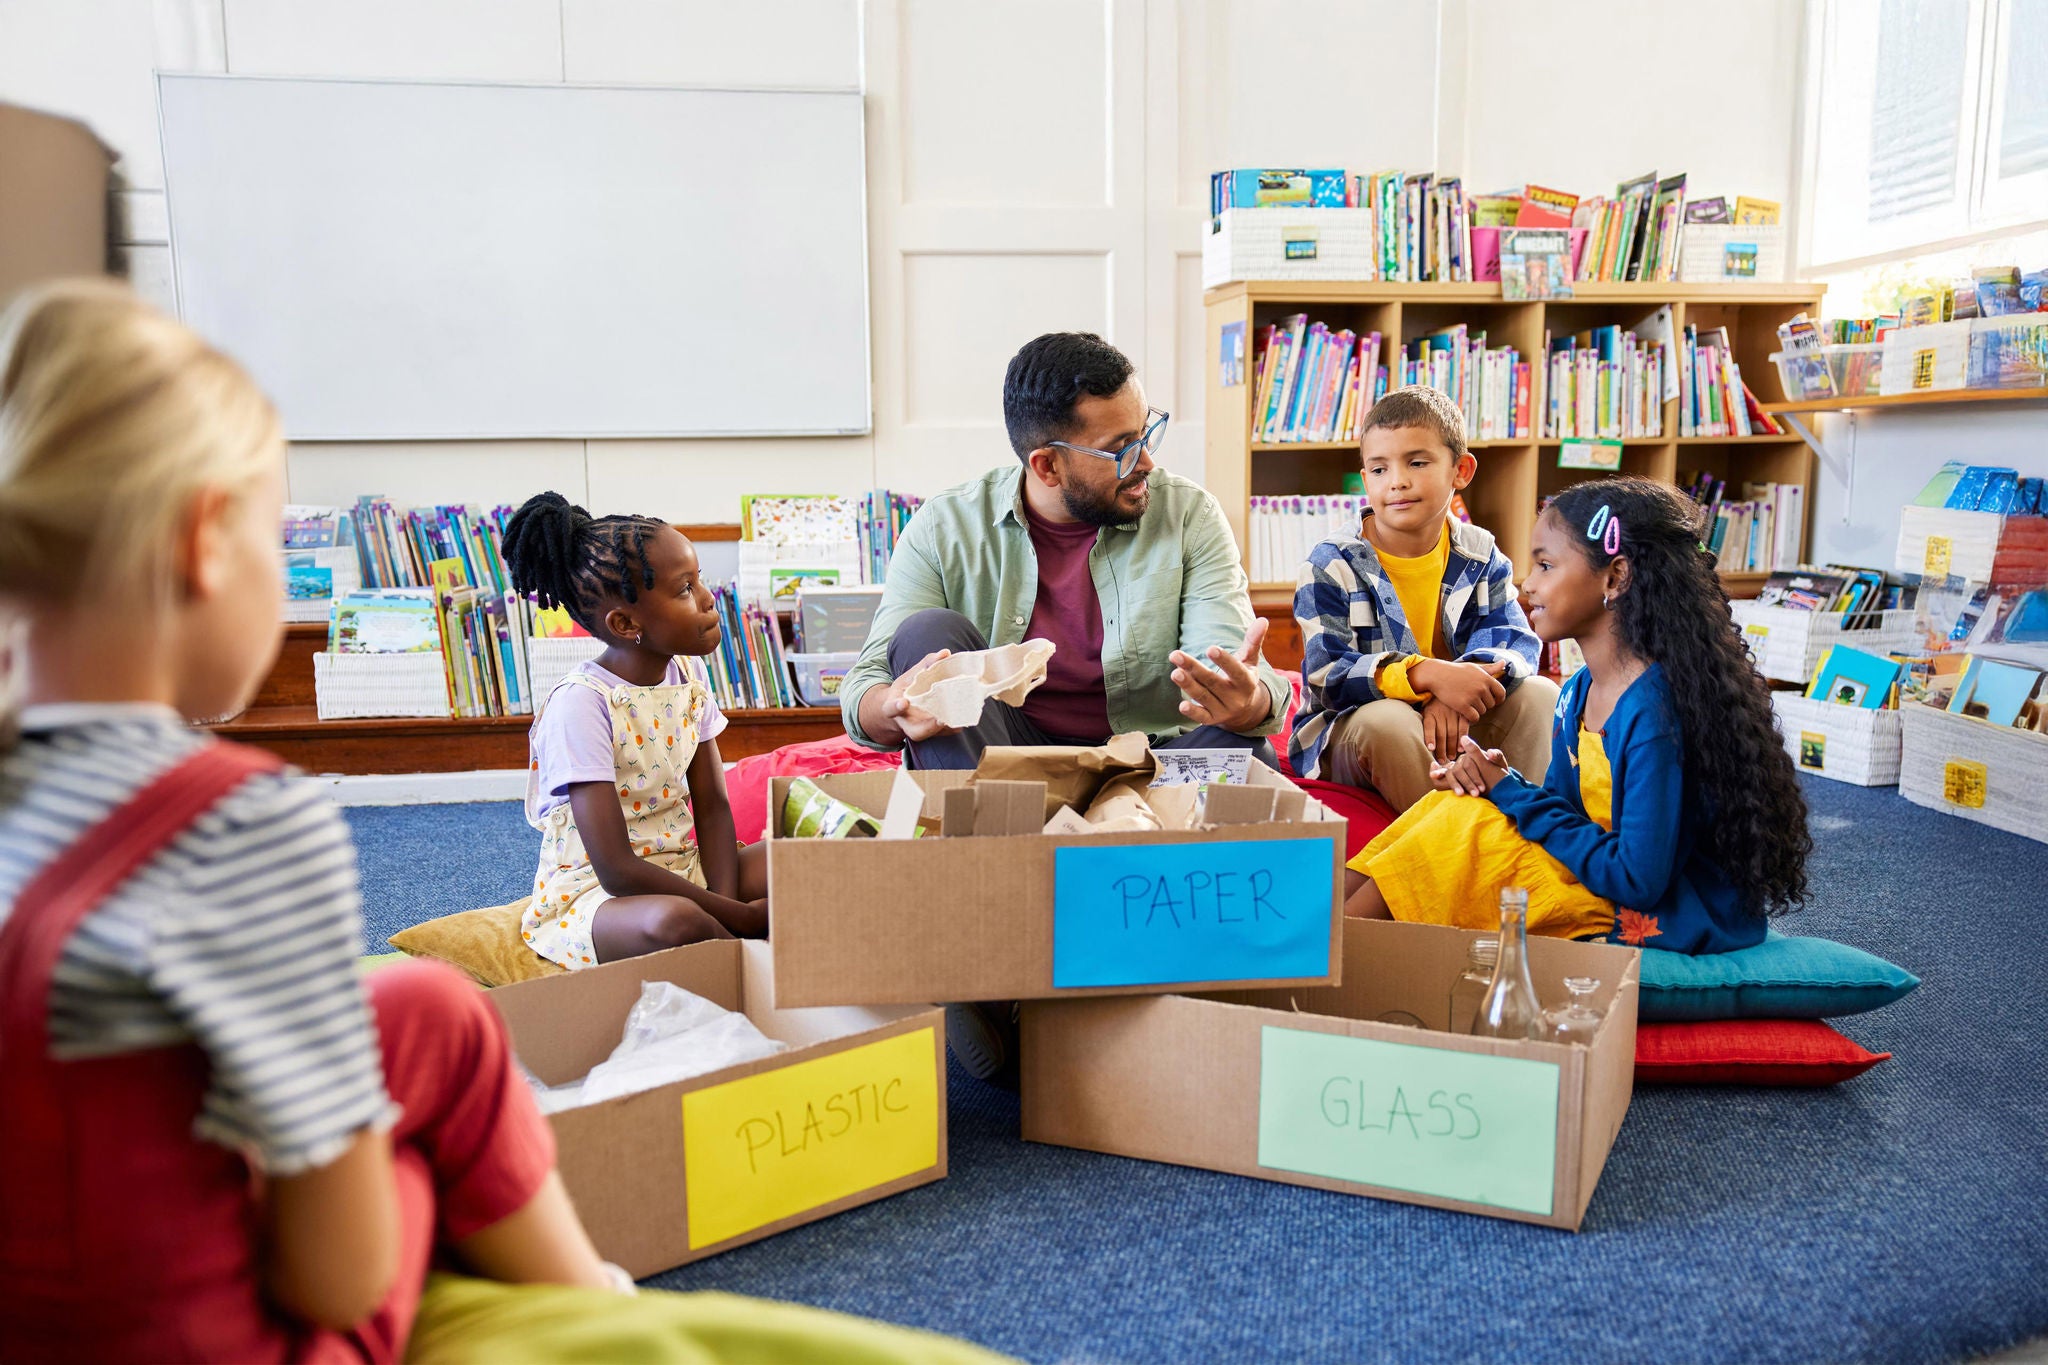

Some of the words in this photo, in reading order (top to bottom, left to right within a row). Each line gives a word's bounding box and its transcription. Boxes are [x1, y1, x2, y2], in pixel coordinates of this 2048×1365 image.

[1514, 237, 1565, 253] MINECRAFT
[1112, 869, 1287, 929] PAPER
[736, 1077, 909, 1174] PLASTIC
[1320, 1075, 1481, 1141] GLASS
